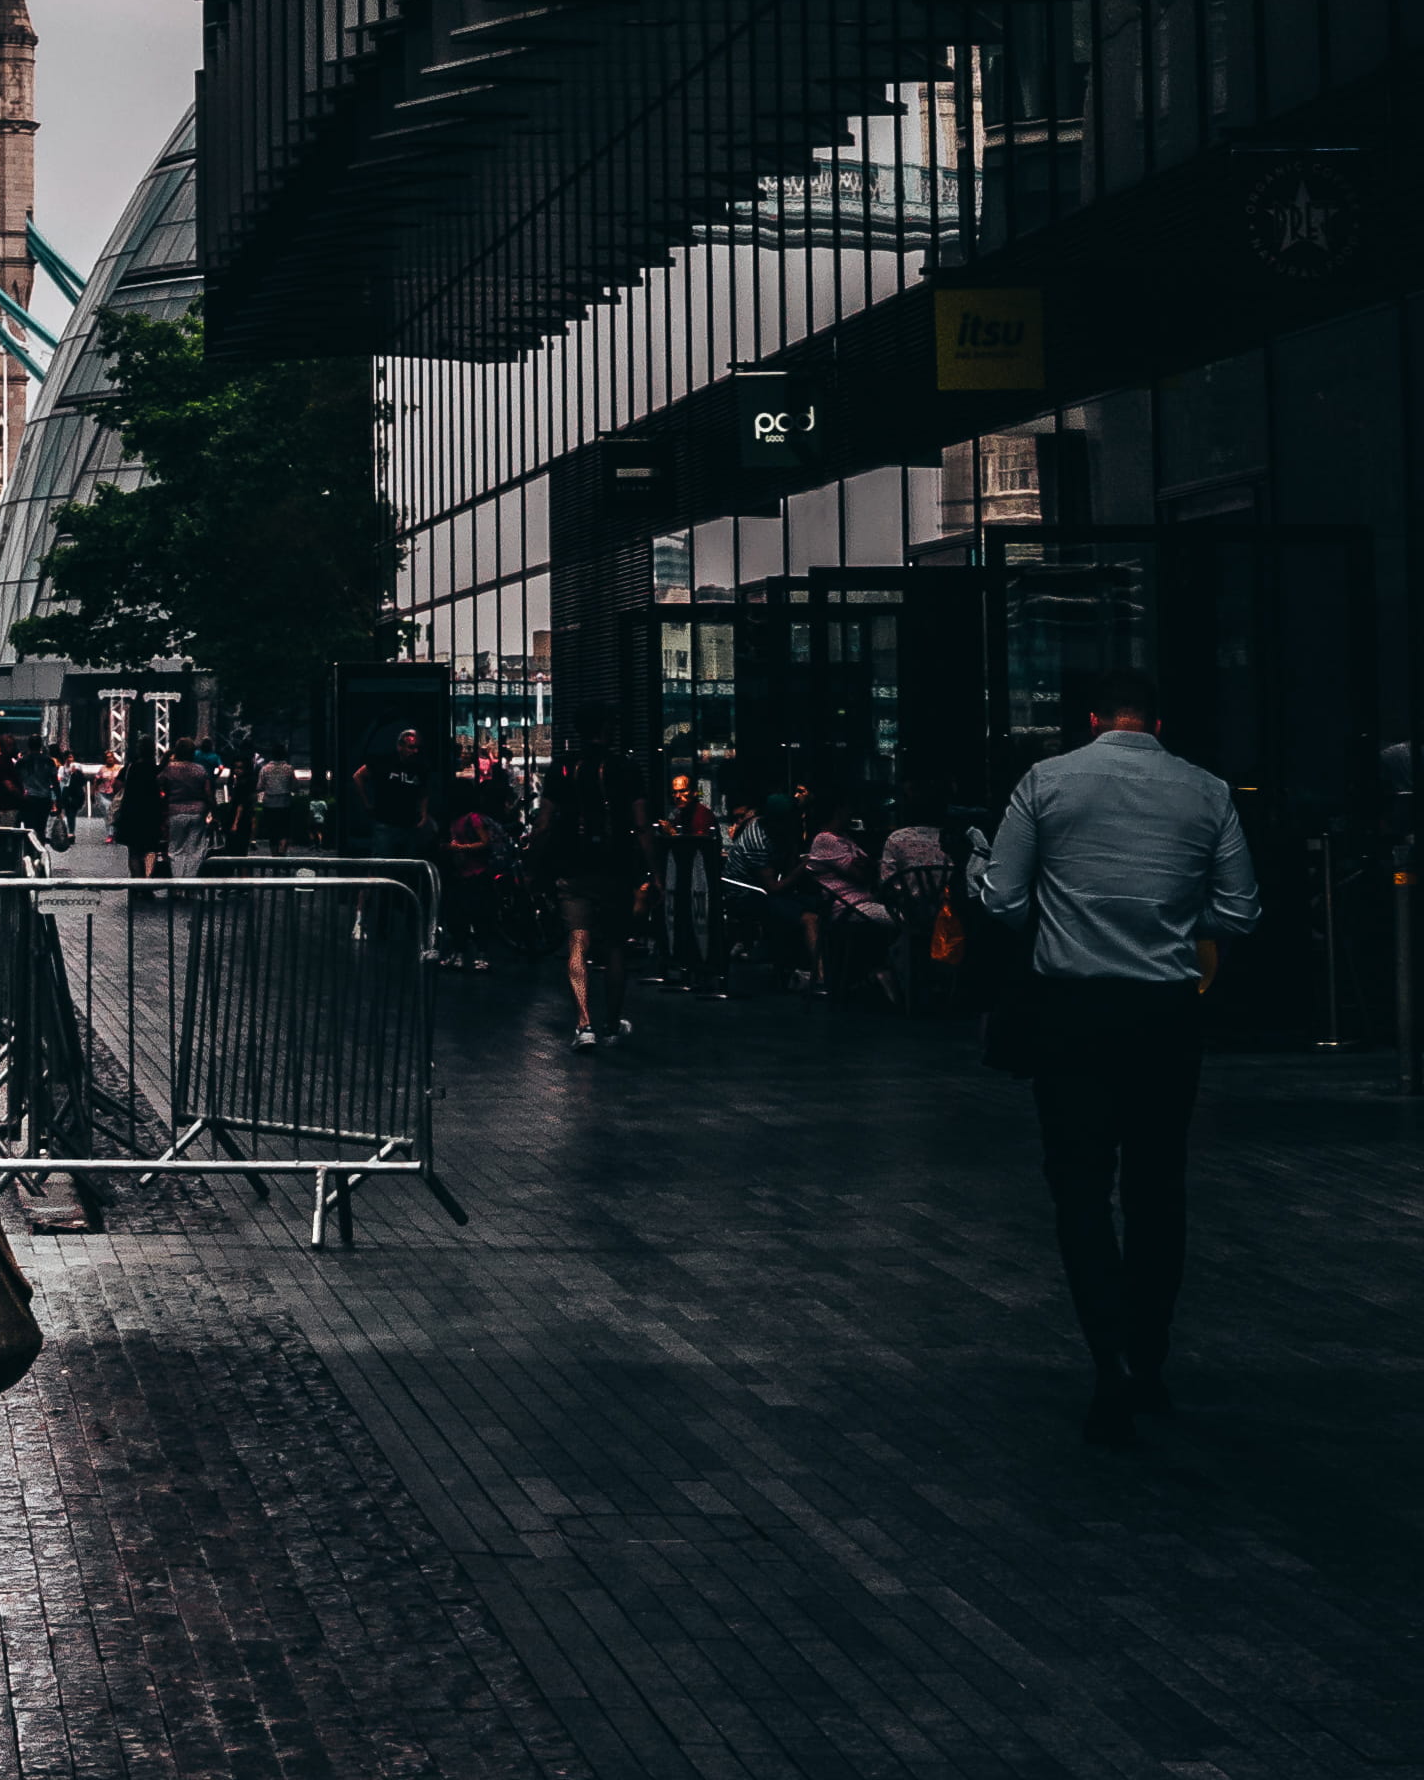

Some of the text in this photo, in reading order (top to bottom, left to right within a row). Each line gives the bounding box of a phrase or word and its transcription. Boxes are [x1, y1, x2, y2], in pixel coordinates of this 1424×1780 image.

[1273, 199, 1339, 242] PRET
[957, 311, 1025, 346] itsu
[754, 405, 815, 440] pod
[389, 771, 421, 784] FILA
